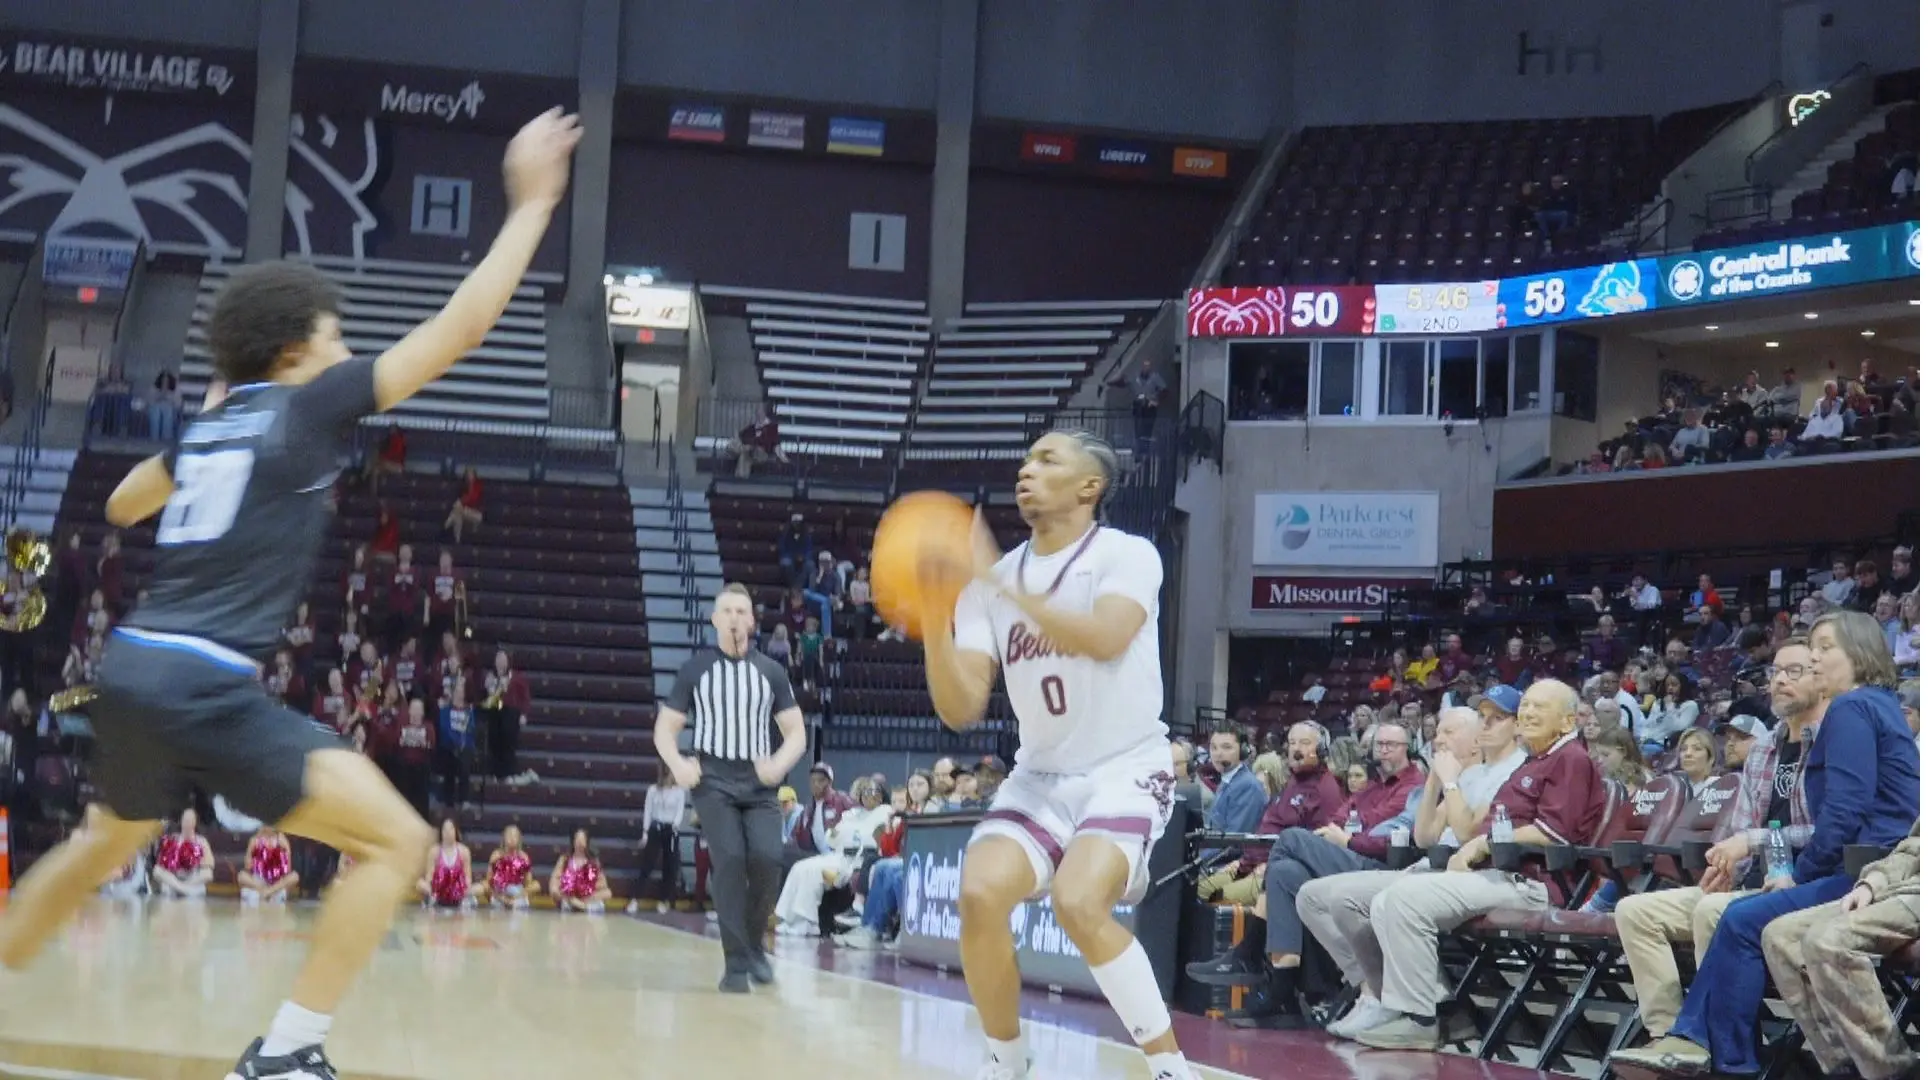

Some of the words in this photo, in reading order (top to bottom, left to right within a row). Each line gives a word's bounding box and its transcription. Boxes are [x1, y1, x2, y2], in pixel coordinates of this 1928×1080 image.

[14, 41, 86, 86] BEAR
[92, 49, 202, 90] VILLAGE
[381, 83, 463, 124] Mercy
[1100, 149, 1147, 164] LIBERTY
[422, 183, 460, 230] H
[1709, 244, 1789, 278] Central
[1789, 236, 1851, 267] Bank
[1405, 286, 1470, 313] 5:46
[1524, 277, 1566, 318] 58
[1710, 277, 1728, 296] of
[1728, 275, 1754, 294] the
[1754, 267, 1812, 290] Ozarks
[1290, 292, 1339, 328] 50
[1422, 315, 1461, 332] 2ND
[1319, 502, 1414, 524] Parkcrest
[1316, 526, 1363, 540] DENTAL
[1368, 527, 1416, 540] GROUP
[1268, 583, 1362, 605] Missouri
[1040, 674, 1067, 716] 0
[924, 848, 963, 901] Central
